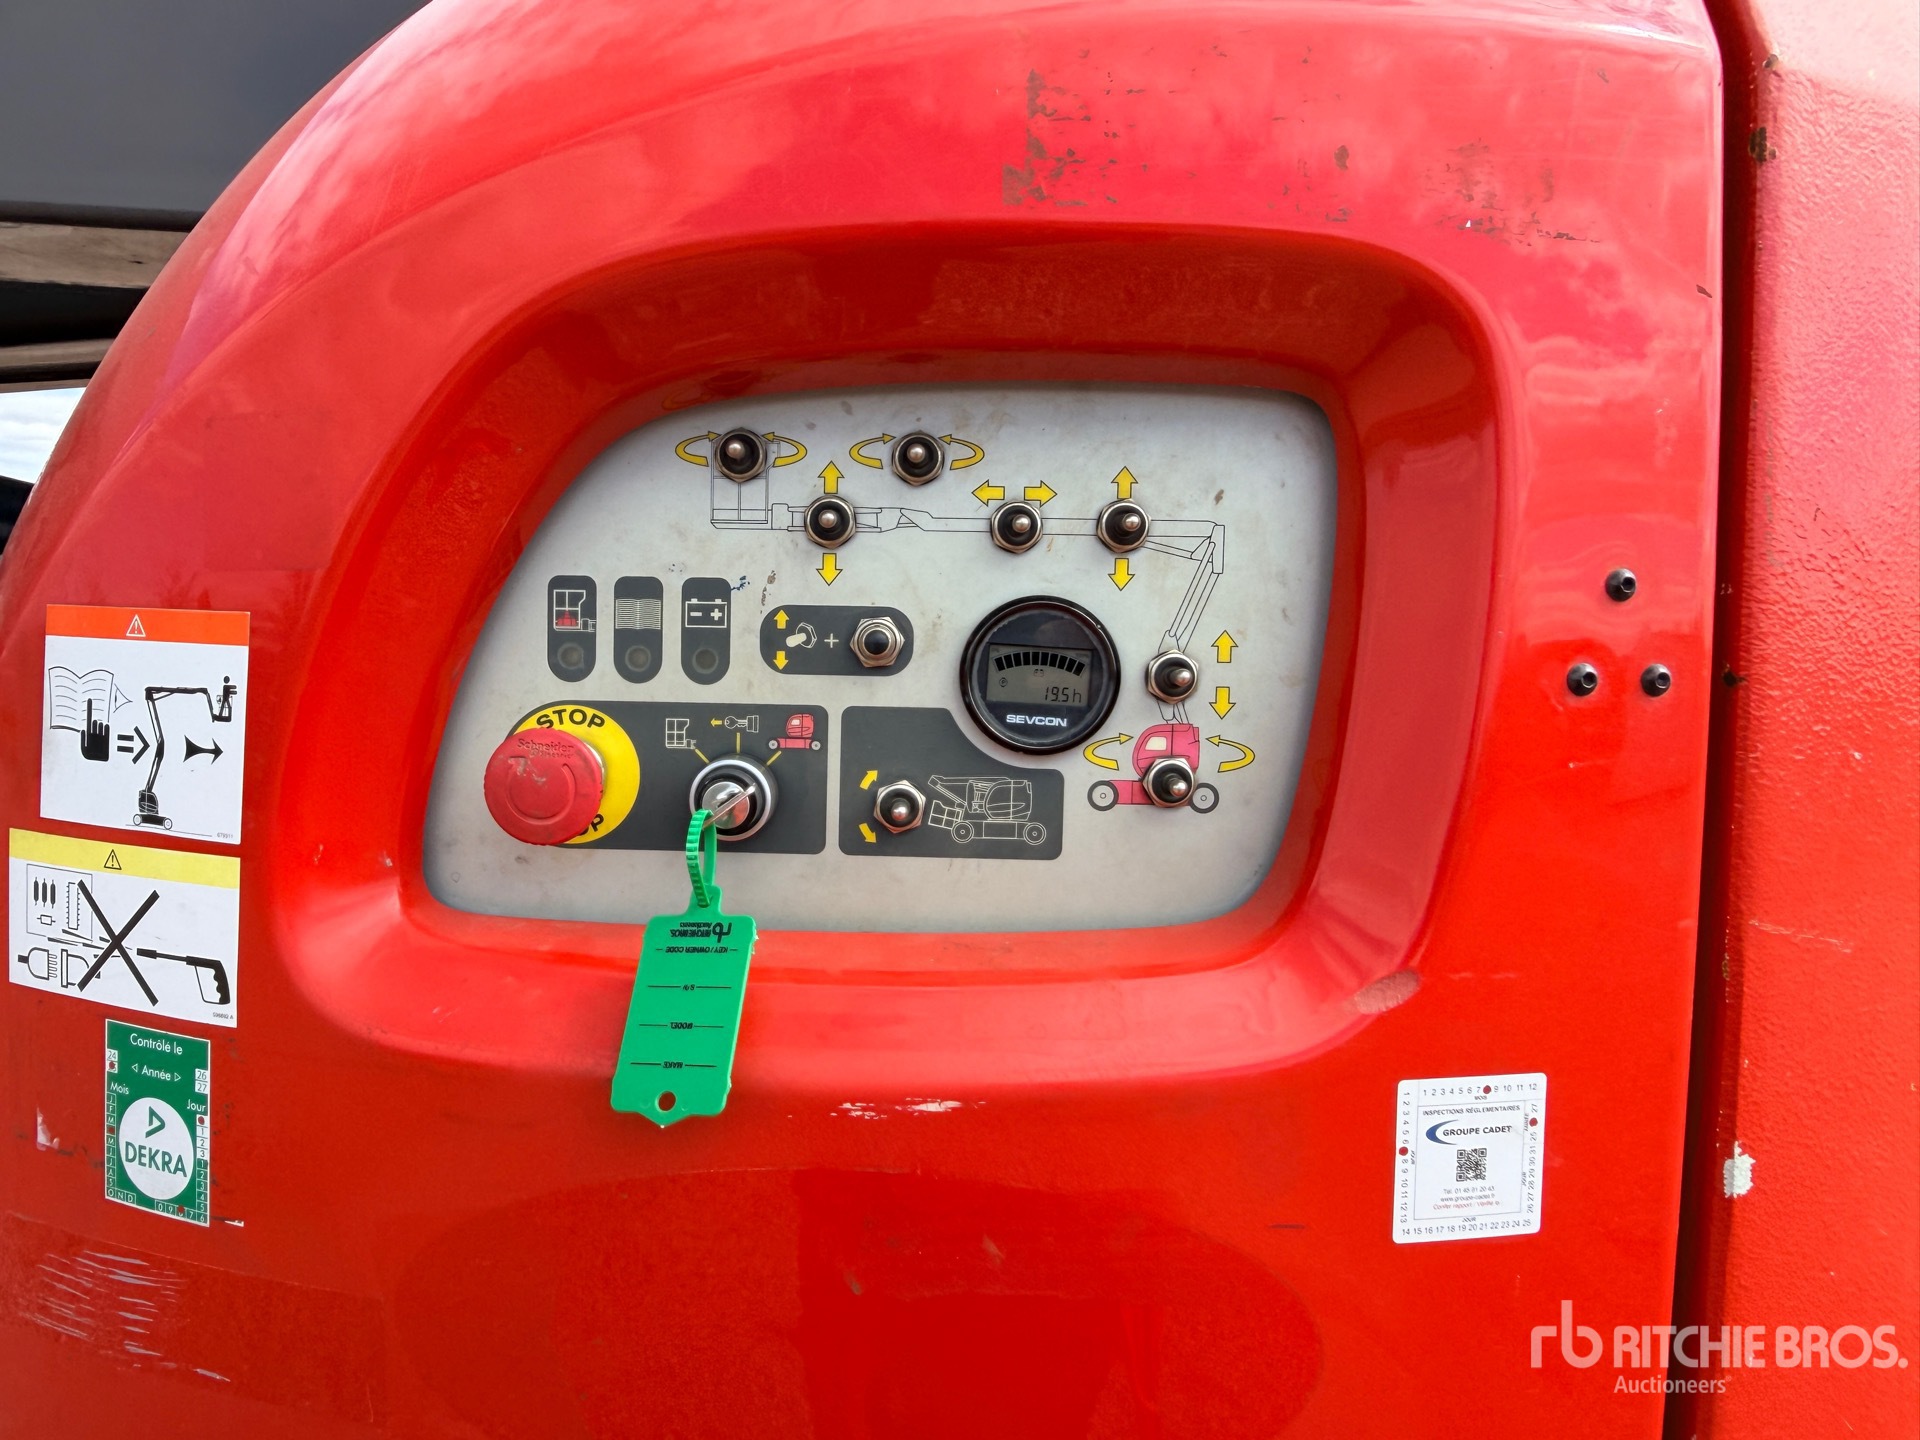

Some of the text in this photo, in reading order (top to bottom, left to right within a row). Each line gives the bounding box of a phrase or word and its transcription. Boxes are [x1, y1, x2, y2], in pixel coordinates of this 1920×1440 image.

[536, 708, 605, 729] STOP
[1006, 714, 1067, 727] SEVCON
[130, 1033, 183, 1055] Contrôlé le
[107, 1050, 116, 1060] 24
[141, 1065, 171, 1081] Année
[197, 1071, 207, 1080] 26
[110, 1082, 129, 1095] Mois
[197, 1083, 207, 1092] 27
[187, 1099, 206, 1112] Jour
[1422, 1108, 1464, 1116] INSPECTIONS
[1443, 1125, 1512, 1137] GROUPE CADET
[1529, 1145, 1536, 1154] 31
[125, 1141, 187, 1178] DEKRA
[1529, 1156, 1536, 1166] 30
[1401, 1178, 1408, 1188] 10
[1401, 1190, 1408, 1198] 11
[1527, 1192, 1534, 1201] 27
[1400, 1202, 1408, 1211] 12
[1400, 1214, 1407, 1223] 13
[1413, 1227, 1422, 1235] 15
[1468, 1223, 1477, 1231] 20
[1501, 1220, 1510, 1228] 23
[1511, 1220, 1520, 1228] 24
